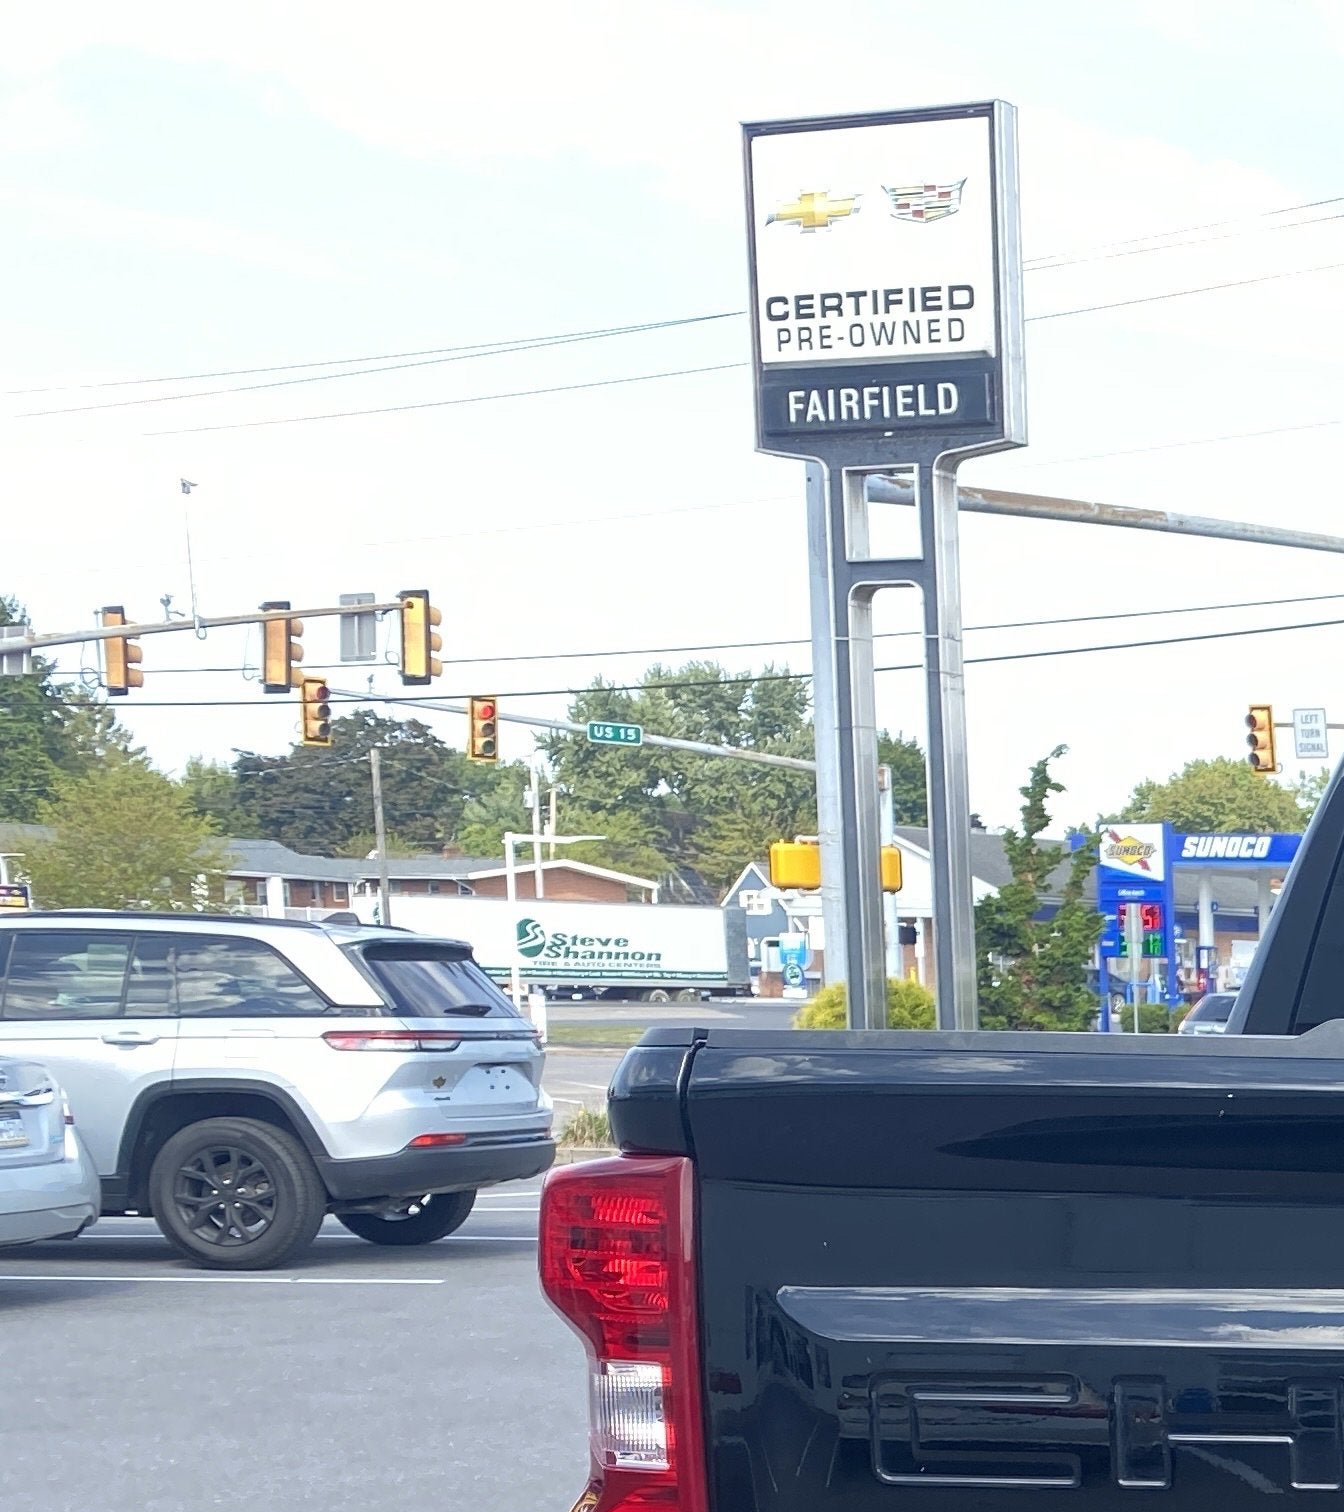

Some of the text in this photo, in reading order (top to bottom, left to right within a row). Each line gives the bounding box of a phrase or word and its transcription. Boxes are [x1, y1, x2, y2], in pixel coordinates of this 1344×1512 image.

[765, 284, 975, 321] CERTIFIED
[777, 317, 966, 352] PRE-OWNED
[788, 382, 959, 424] FAIRFIELD
[1300, 714, 1319, 725] LEFT
[594, 725, 637, 741] US 15
[1301, 728, 1321, 739] TURN
[1299, 742, 1326, 753] SIGNAL
[1107, 843, 1153, 858] SUNOCO
[1181, 836, 1272, 858] SUNOCO
[550, 932, 629, 947] Steve
[544, 945, 662, 962] Shannon
